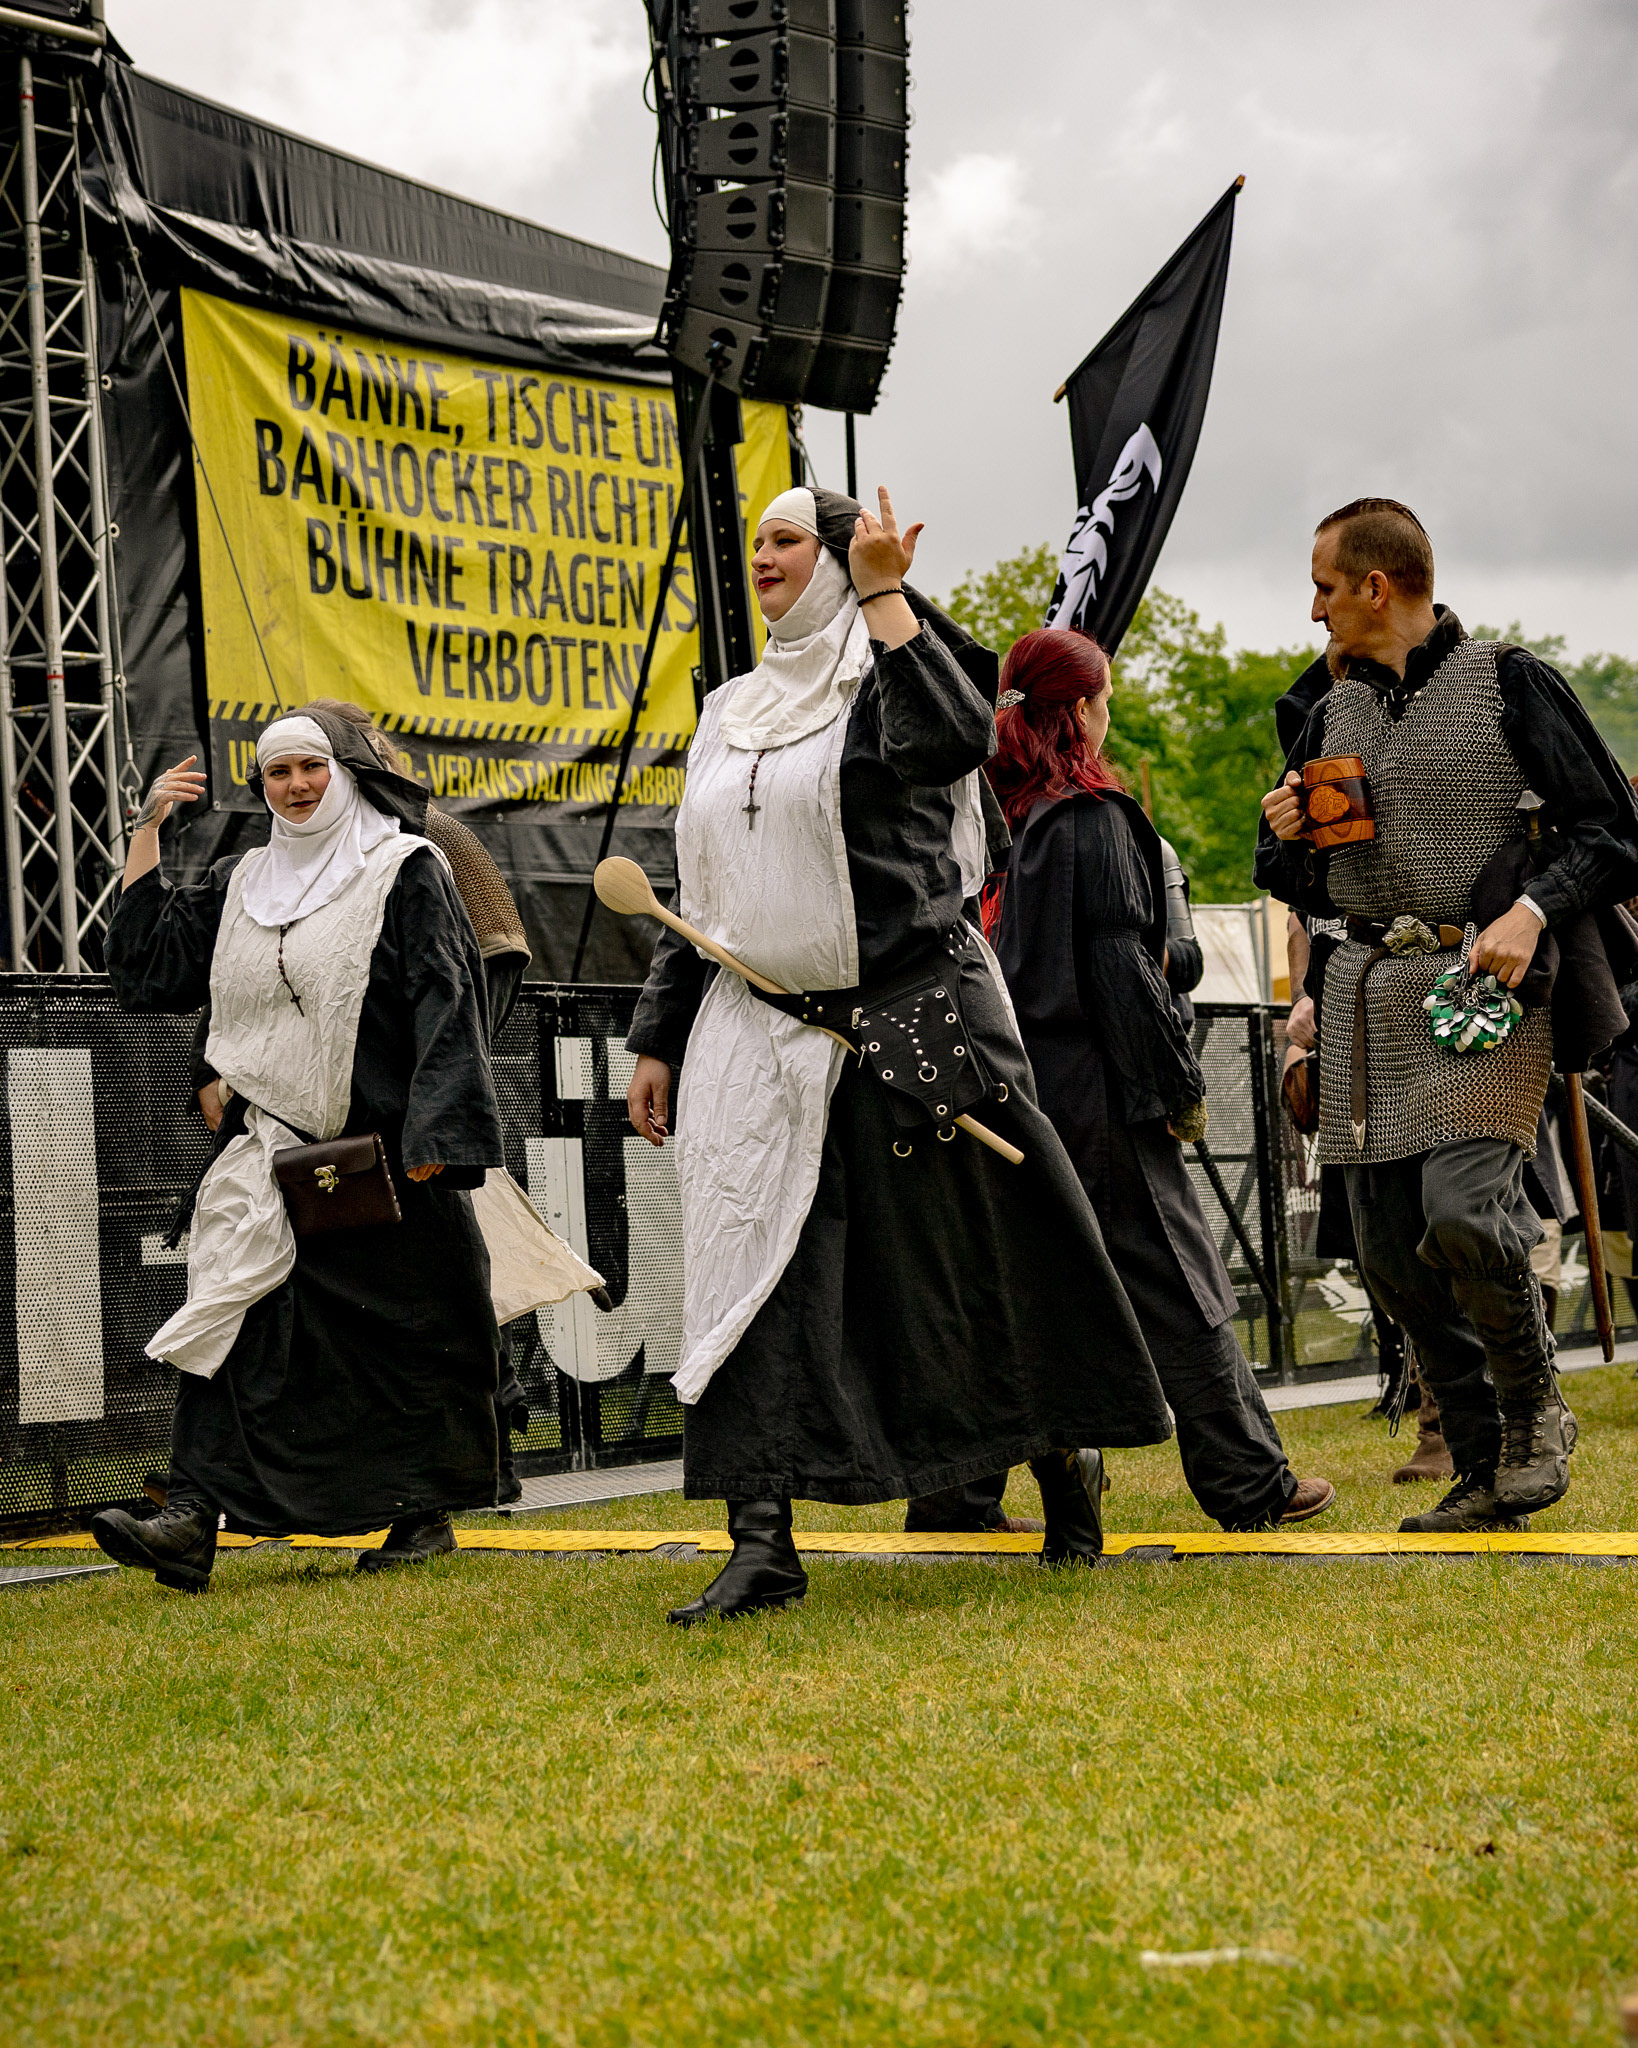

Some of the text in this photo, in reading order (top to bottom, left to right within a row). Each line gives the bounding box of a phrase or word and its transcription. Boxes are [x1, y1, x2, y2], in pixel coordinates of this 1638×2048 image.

[287, 332, 680, 470] BÄNKE, TISCHE UN
[255, 417, 538, 533] BARHOCKER
[307, 511, 465, 611] BÜHNE
[478, 541, 645, 631] TRAGEN
